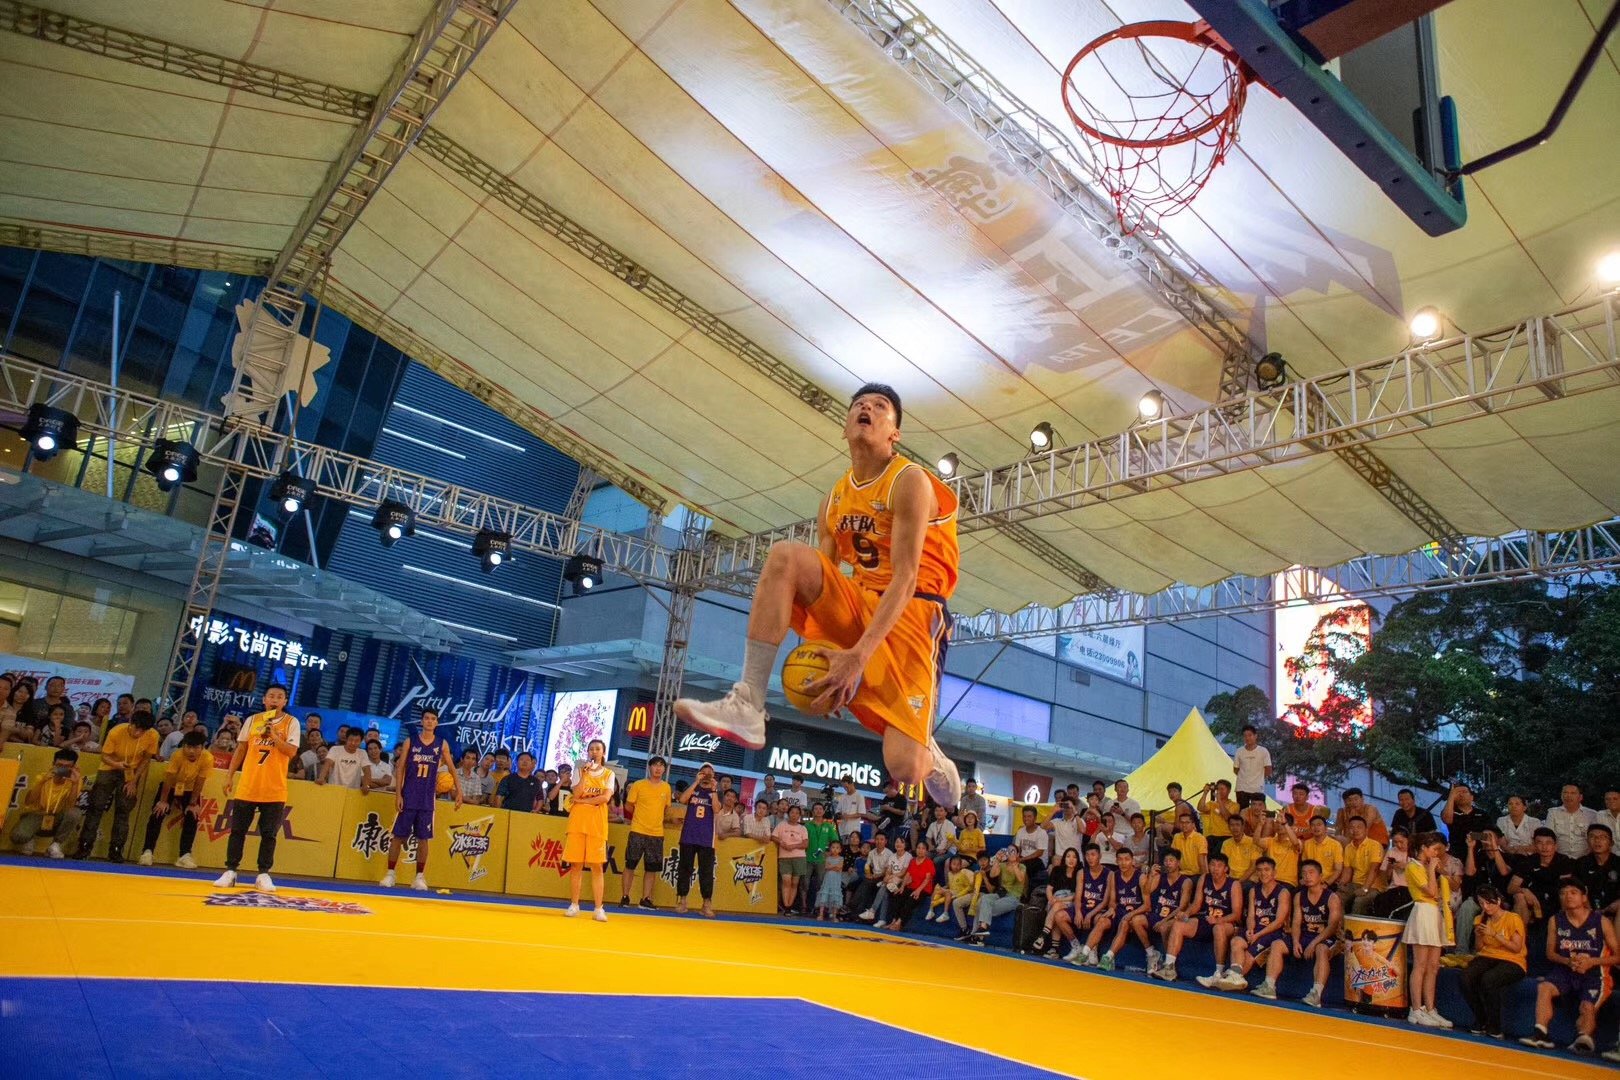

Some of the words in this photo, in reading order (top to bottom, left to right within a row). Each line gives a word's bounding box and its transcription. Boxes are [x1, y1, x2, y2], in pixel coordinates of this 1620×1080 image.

[449, 679, 526, 726] Show
[257, 748, 271, 766] 7
[768, 746, 882, 787] McDonald's
[416, 763, 430, 778] 11
[695, 805, 706, 819] 8
[449, 832, 489, 854] 冰红茶
